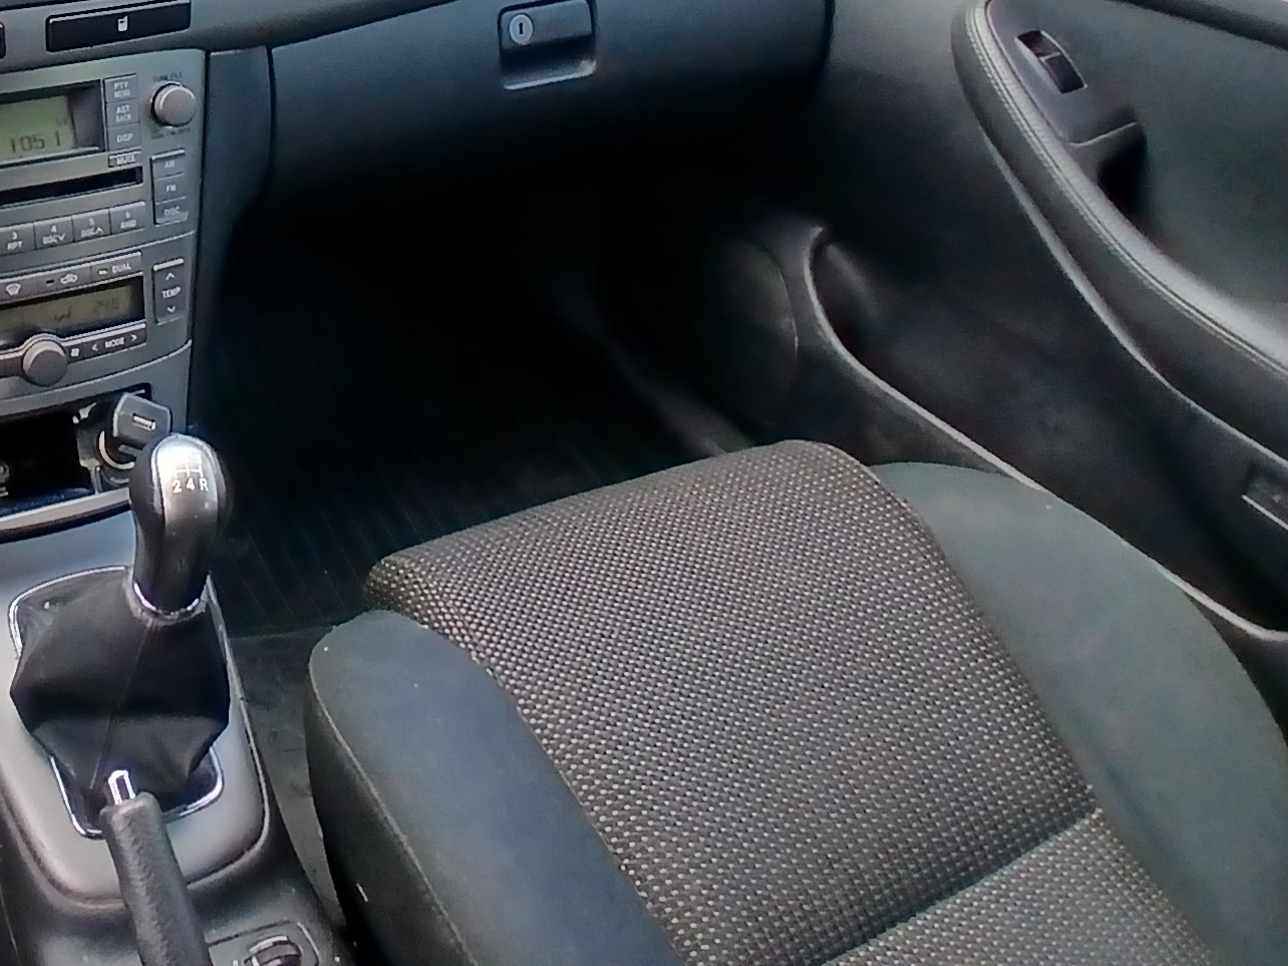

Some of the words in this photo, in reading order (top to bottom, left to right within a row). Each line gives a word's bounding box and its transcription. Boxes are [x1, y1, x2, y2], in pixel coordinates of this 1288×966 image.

[112, 263, 132, 273] DUAL
[173, 479, 182, 493] 2
[186, 478, 195, 491] 4
[199, 477, 209, 492] R
